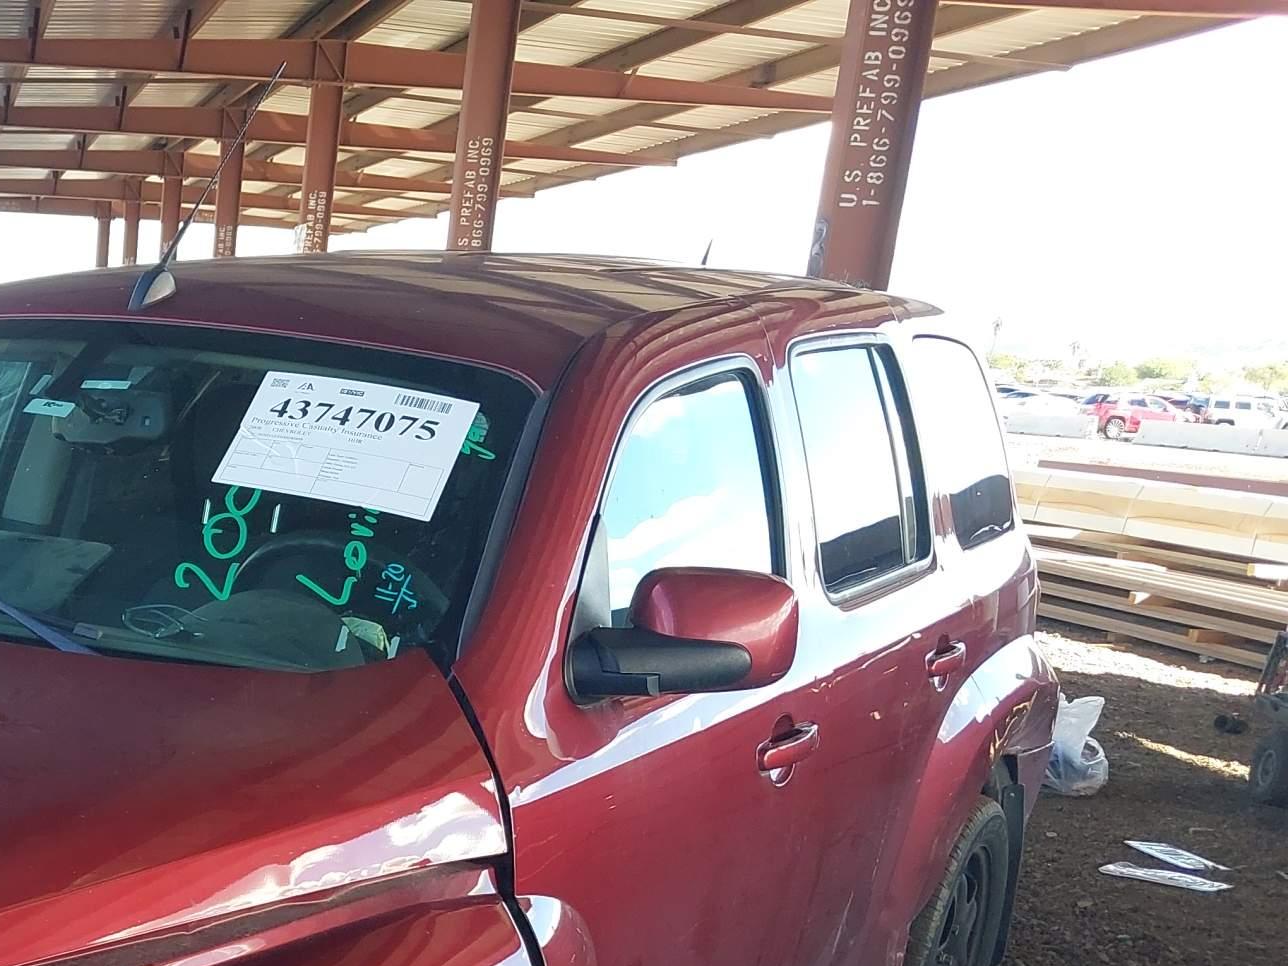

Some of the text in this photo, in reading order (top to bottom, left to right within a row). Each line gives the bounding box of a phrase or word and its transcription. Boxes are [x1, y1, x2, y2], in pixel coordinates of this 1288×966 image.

[849, 51, 882, 146] PREFAB
[460, 170, 476, 225] PREFAB
[251, 416, 299, 428] Progressive
[301, 422, 338, 434] Casualty
[341, 427, 383, 441] Insurance
[269, 398, 441, 441] 43747075
